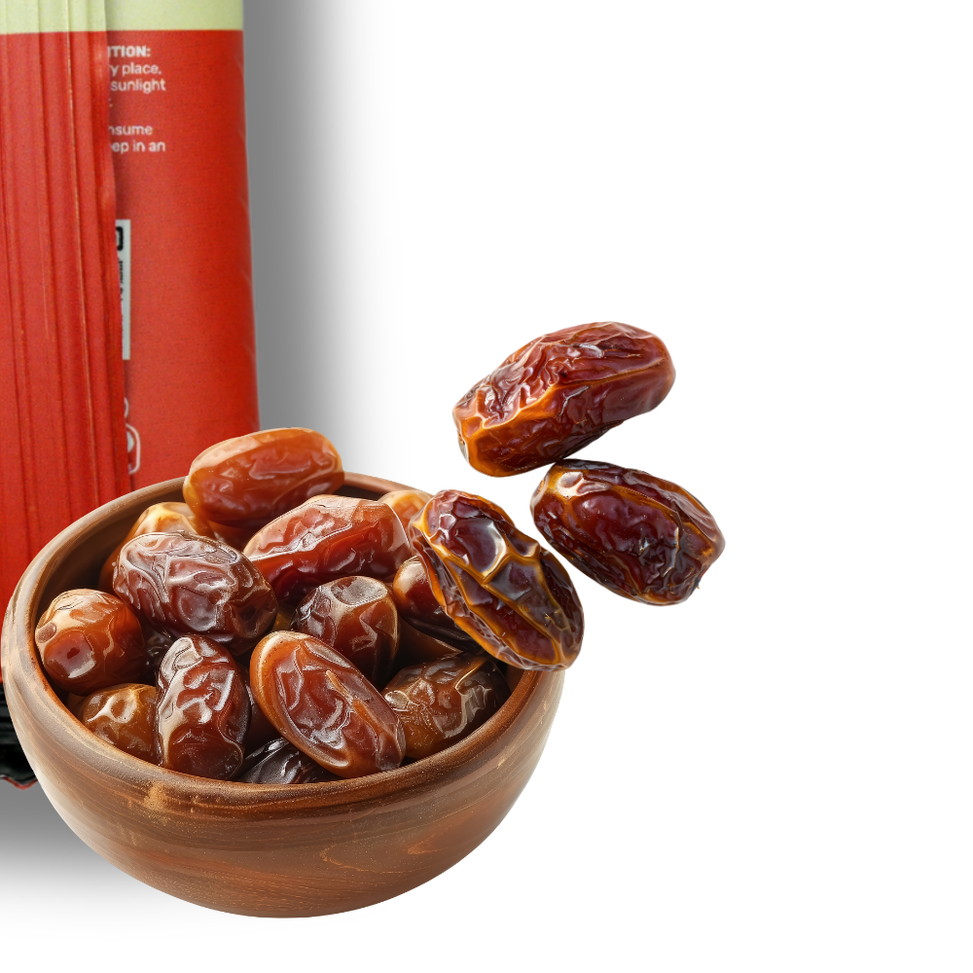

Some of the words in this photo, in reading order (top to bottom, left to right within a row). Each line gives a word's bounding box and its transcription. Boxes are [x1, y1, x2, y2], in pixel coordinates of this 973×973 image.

[110, 79, 166, 94] sunlight
[133, 140, 146, 152] in
[149, 141, 166, 152] an
